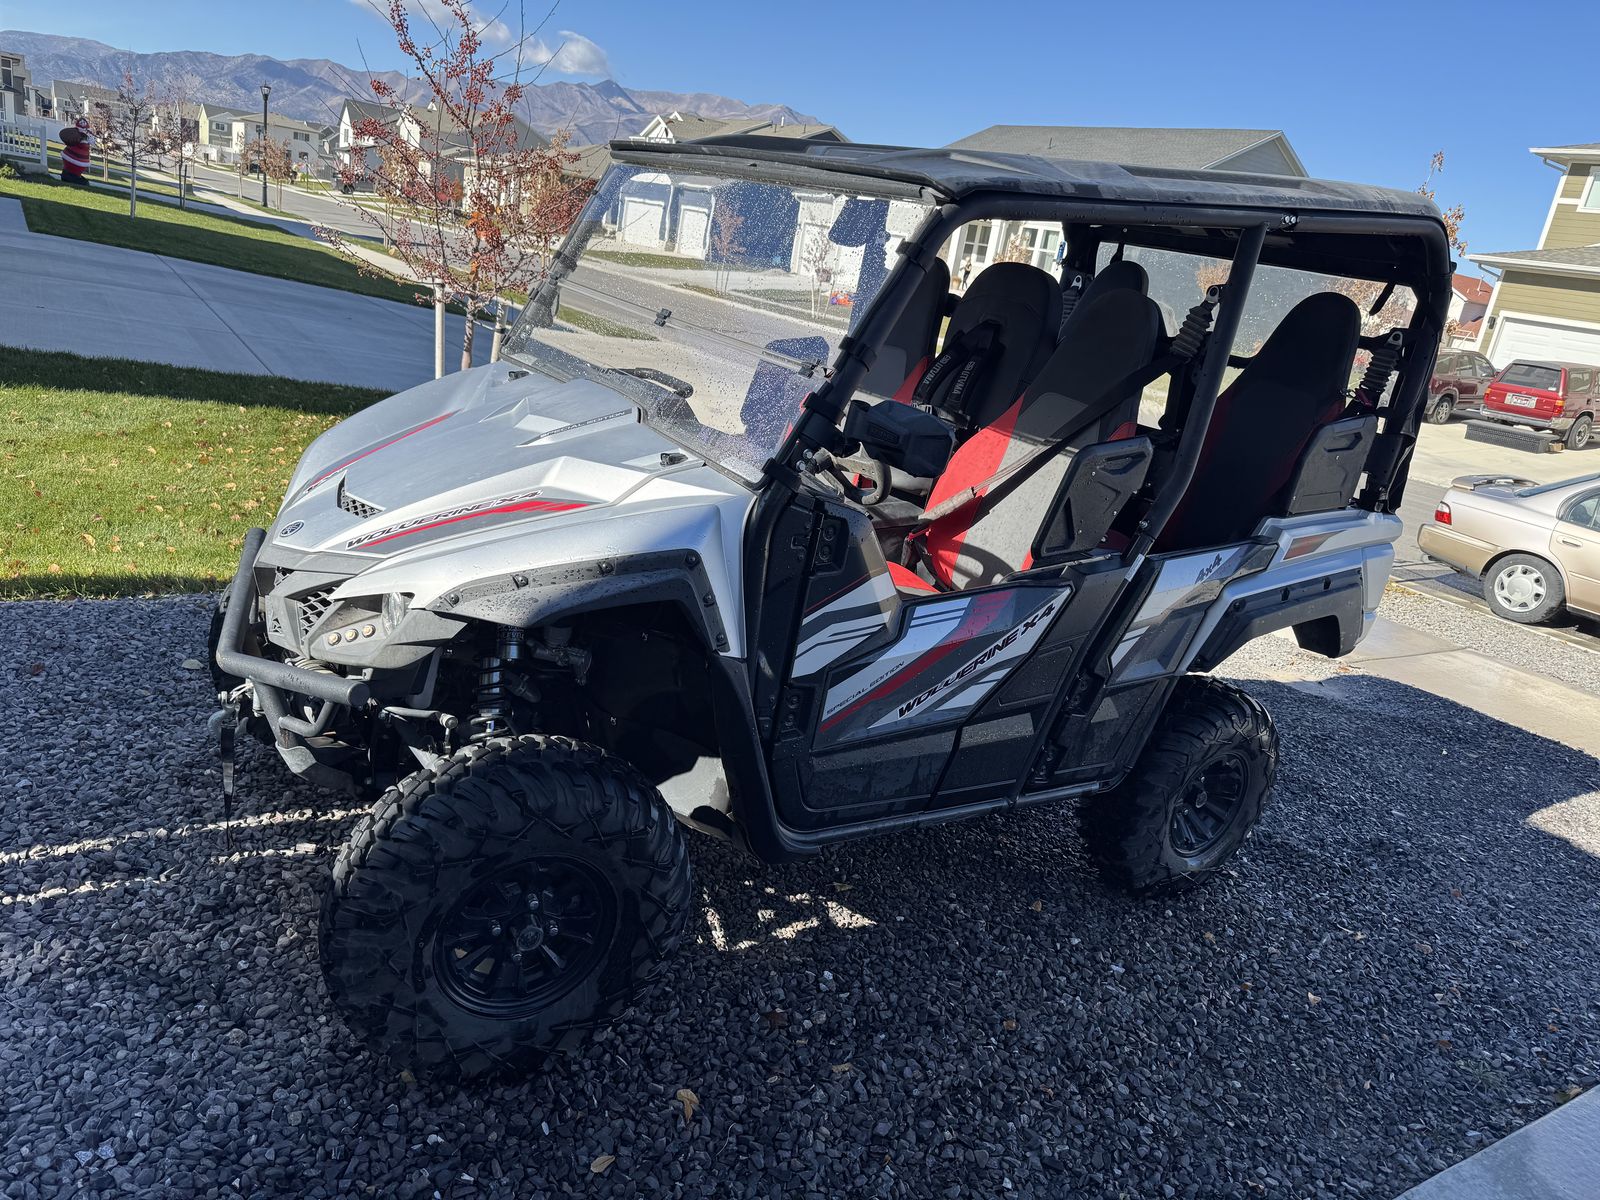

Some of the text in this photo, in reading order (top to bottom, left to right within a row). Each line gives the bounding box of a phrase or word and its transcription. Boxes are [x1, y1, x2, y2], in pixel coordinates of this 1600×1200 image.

[347, 501, 494, 550] WOLVERINE
[826, 660, 905, 715] SPECIAL EDITION
[898, 603, 1056, 718] WOLVERINE X4
